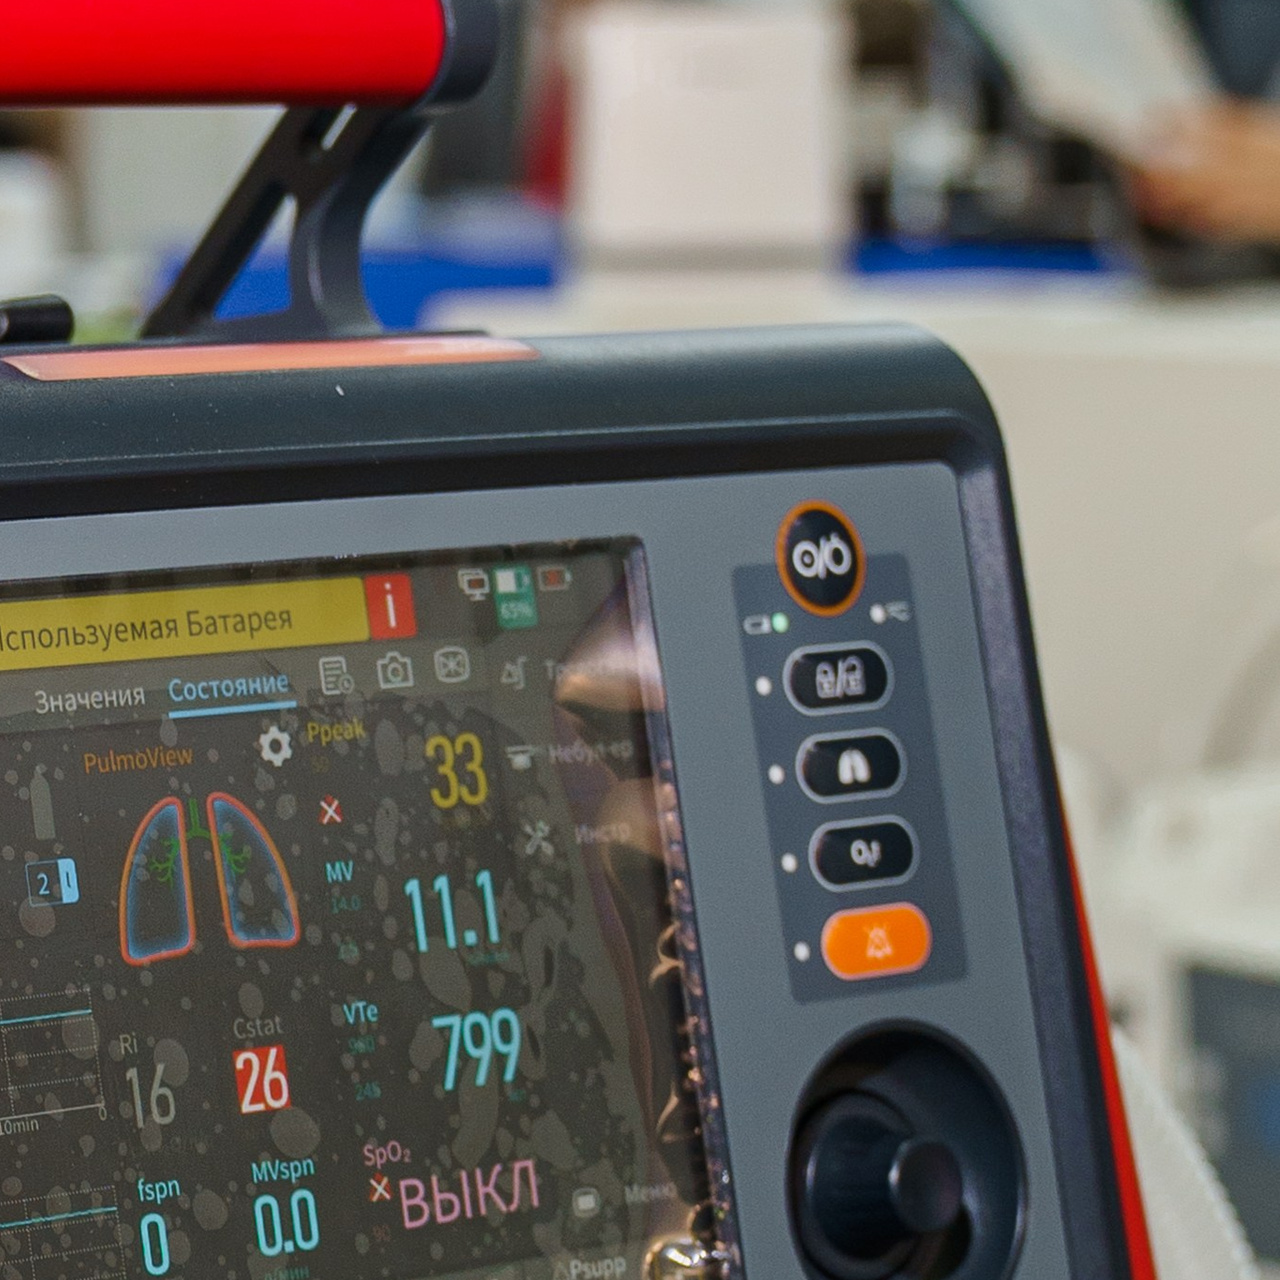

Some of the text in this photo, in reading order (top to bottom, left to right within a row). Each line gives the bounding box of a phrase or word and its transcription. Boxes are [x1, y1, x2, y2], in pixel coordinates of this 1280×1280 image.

[188, 607, 293, 642] Батарея
[35, 687, 145, 714] Значения
[168, 673, 289, 703] Состояние
[307, 718, 365, 746] Ppeak
[84, 747, 193, 774] PulmoView
[425, 732, 489, 809] 33
[37, 874, 50, 895] 2
[325, 860, 354, 884] MV
[404, 869, 501, 953] 11.1
[343, 1001, 379, 1024] VTe
[233, 1016, 284, 1039] Cstat
[120, 1033, 137, 1054] Ri
[432, 1007, 521, 1091] 799
[235, 1047, 289, 1113] 26
[126, 1064, 175, 1129] 16
[252, 1157, 316, 1184] MVspn
[137, 1178, 181, 1204] fspn
[399, 1158, 540, 1230] ВЫКЛ
[254, 1188, 319, 1257] 0.0
[140, 1213, 170, 1276] 0
